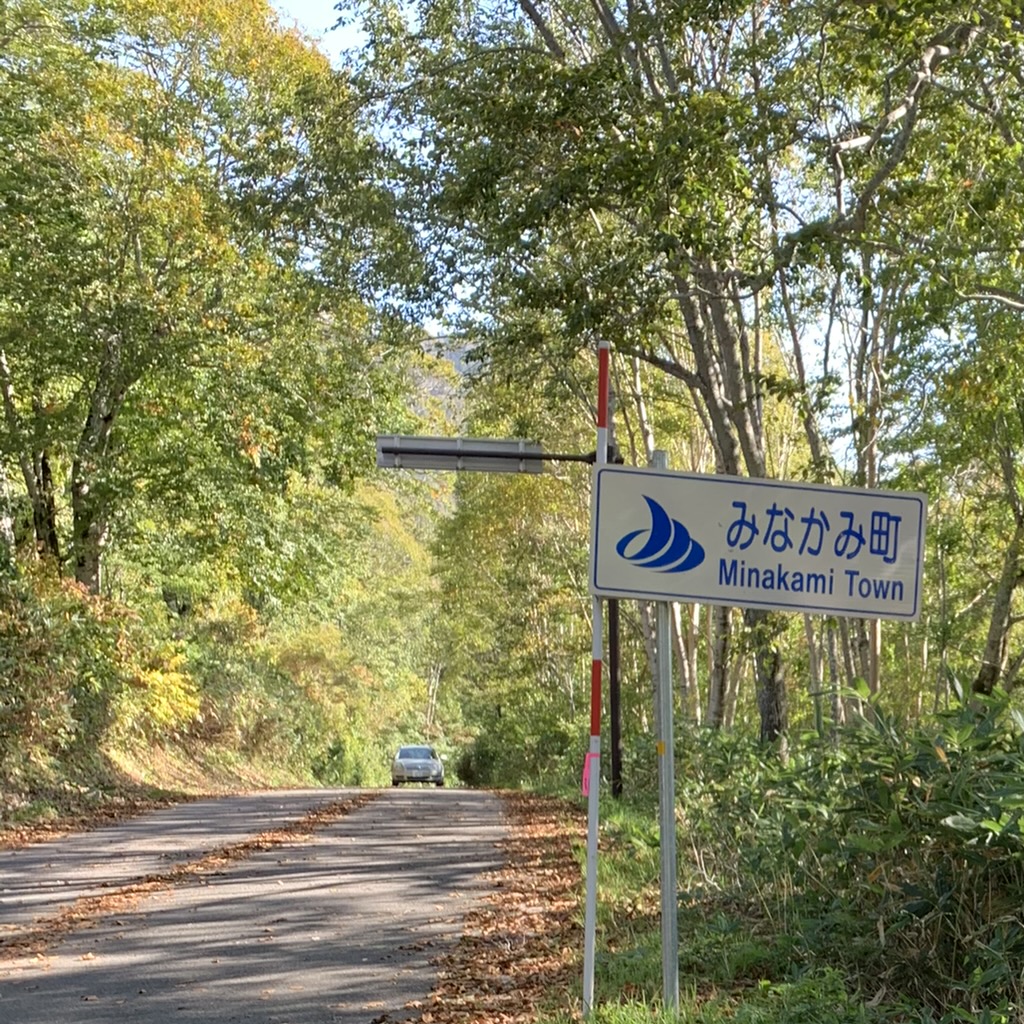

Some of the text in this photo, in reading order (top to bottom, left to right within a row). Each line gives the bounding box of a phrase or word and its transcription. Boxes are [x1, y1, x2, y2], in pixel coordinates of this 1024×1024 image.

[725, 500, 902, 564] みなかみ町
[718, 558, 904, 601] Minakami Town
